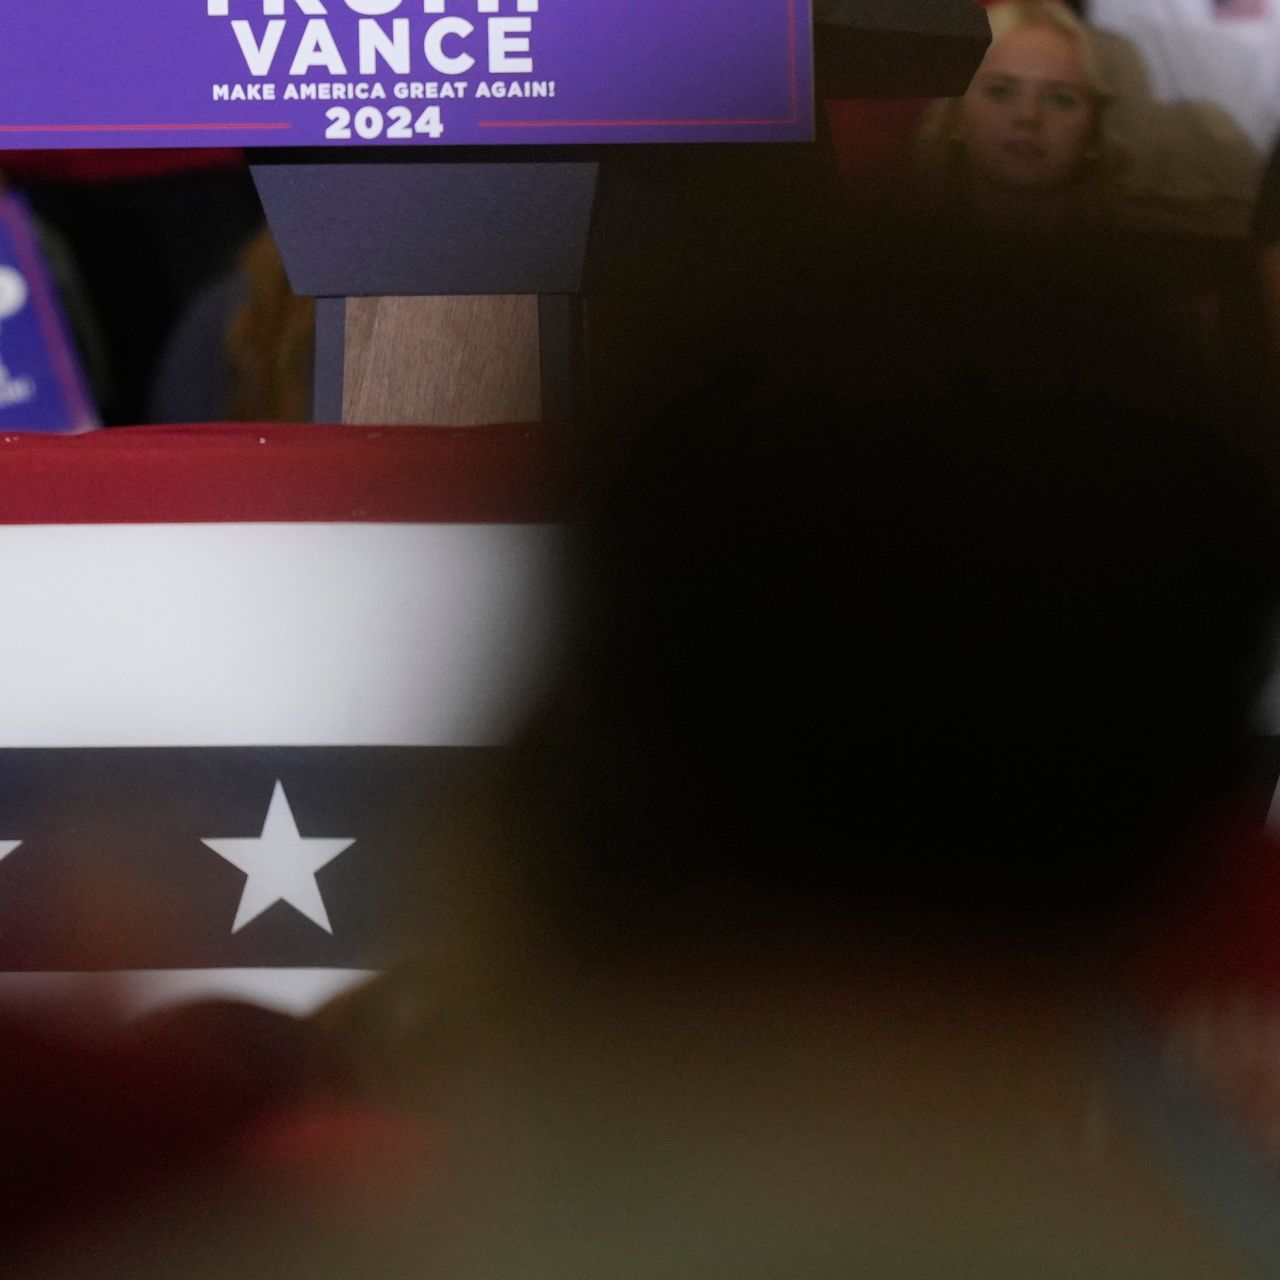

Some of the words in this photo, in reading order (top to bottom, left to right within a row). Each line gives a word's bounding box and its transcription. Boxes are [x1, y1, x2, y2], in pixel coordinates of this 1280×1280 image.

[230, 16, 534, 77] VANCE
[212, 83, 276, 101] MAKE
[282, 81, 387, 100] AMERICA
[393, 80, 468, 99] GREAT
[475, 80, 556, 98] AGAIN!
[324, 105, 444, 140] 2024
